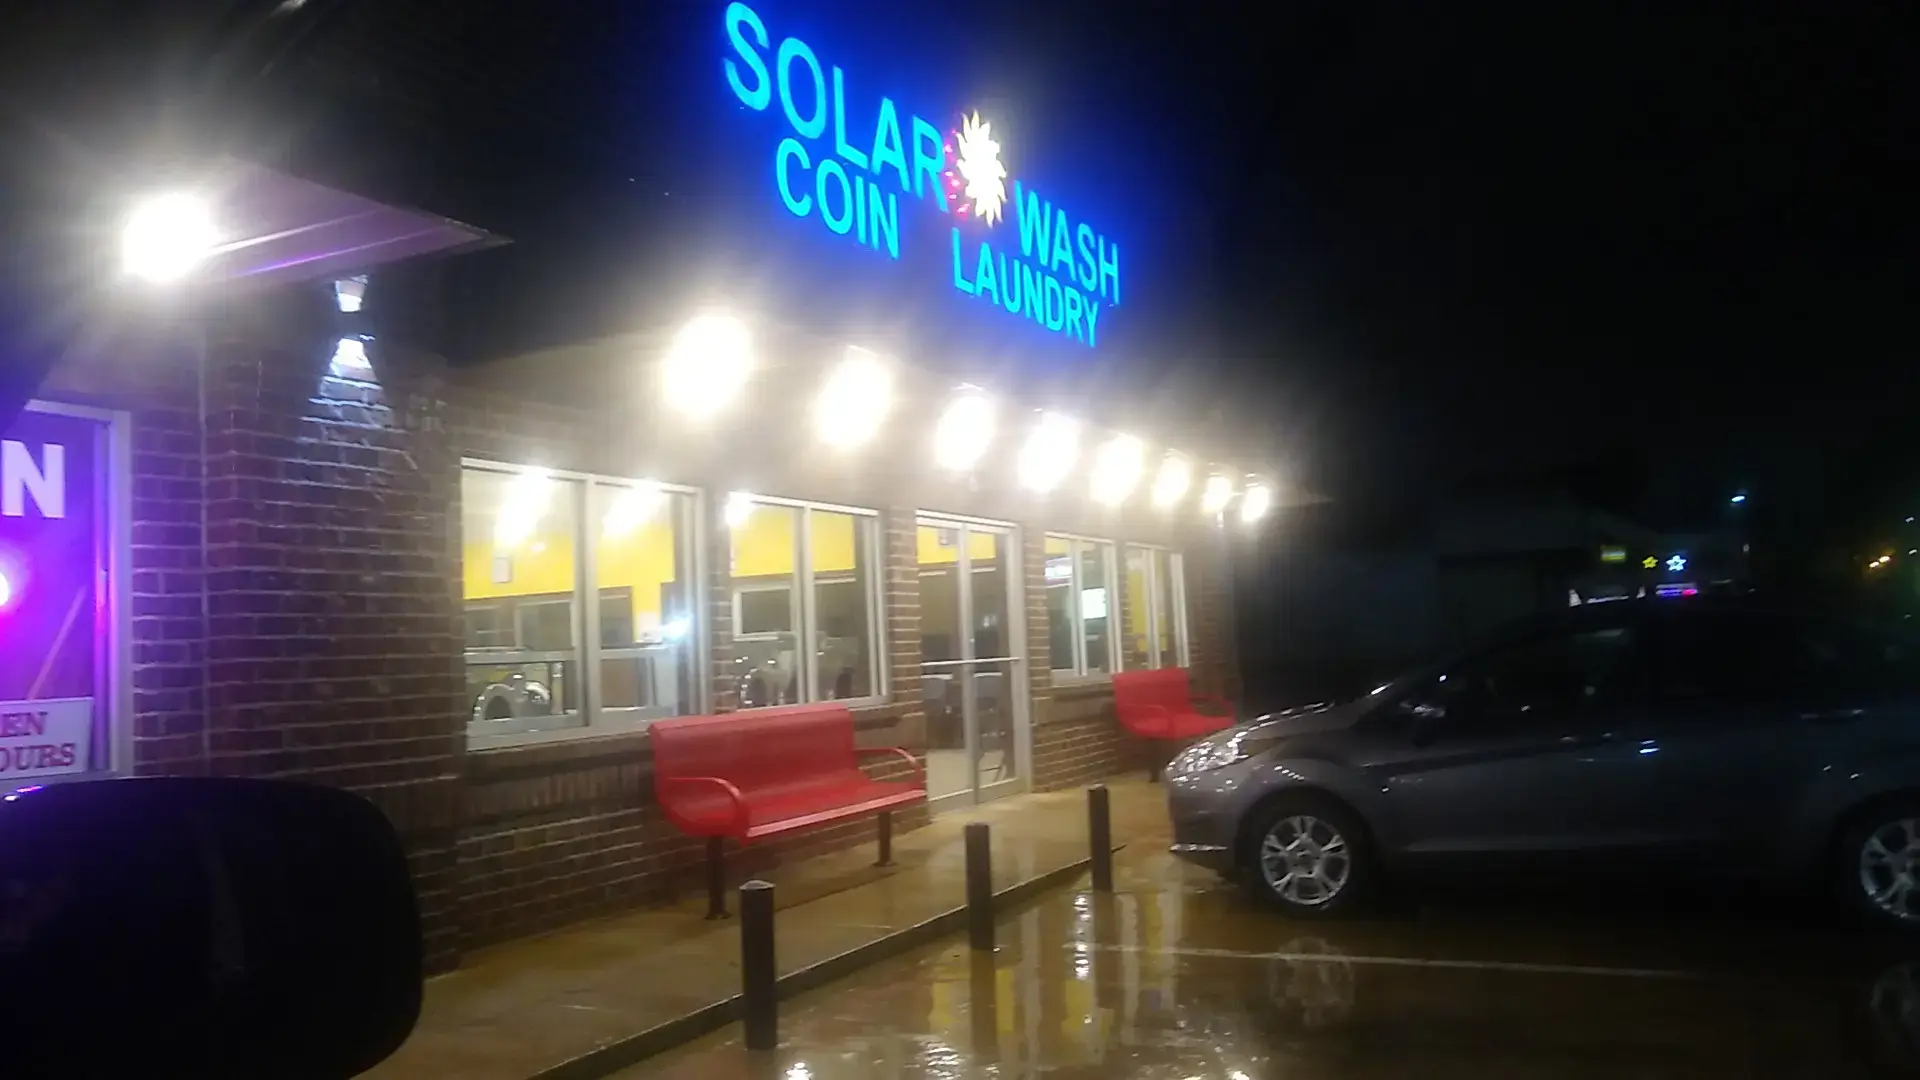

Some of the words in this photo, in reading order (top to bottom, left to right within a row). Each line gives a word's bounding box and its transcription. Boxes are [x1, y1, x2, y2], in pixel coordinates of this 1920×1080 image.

[725, 1, 948, 213] SOLAR
[1014, 179, 1119, 304] WASH
[776, 137, 898, 260] COIN
[952, 227, 1098, 348] LAUNDRY
